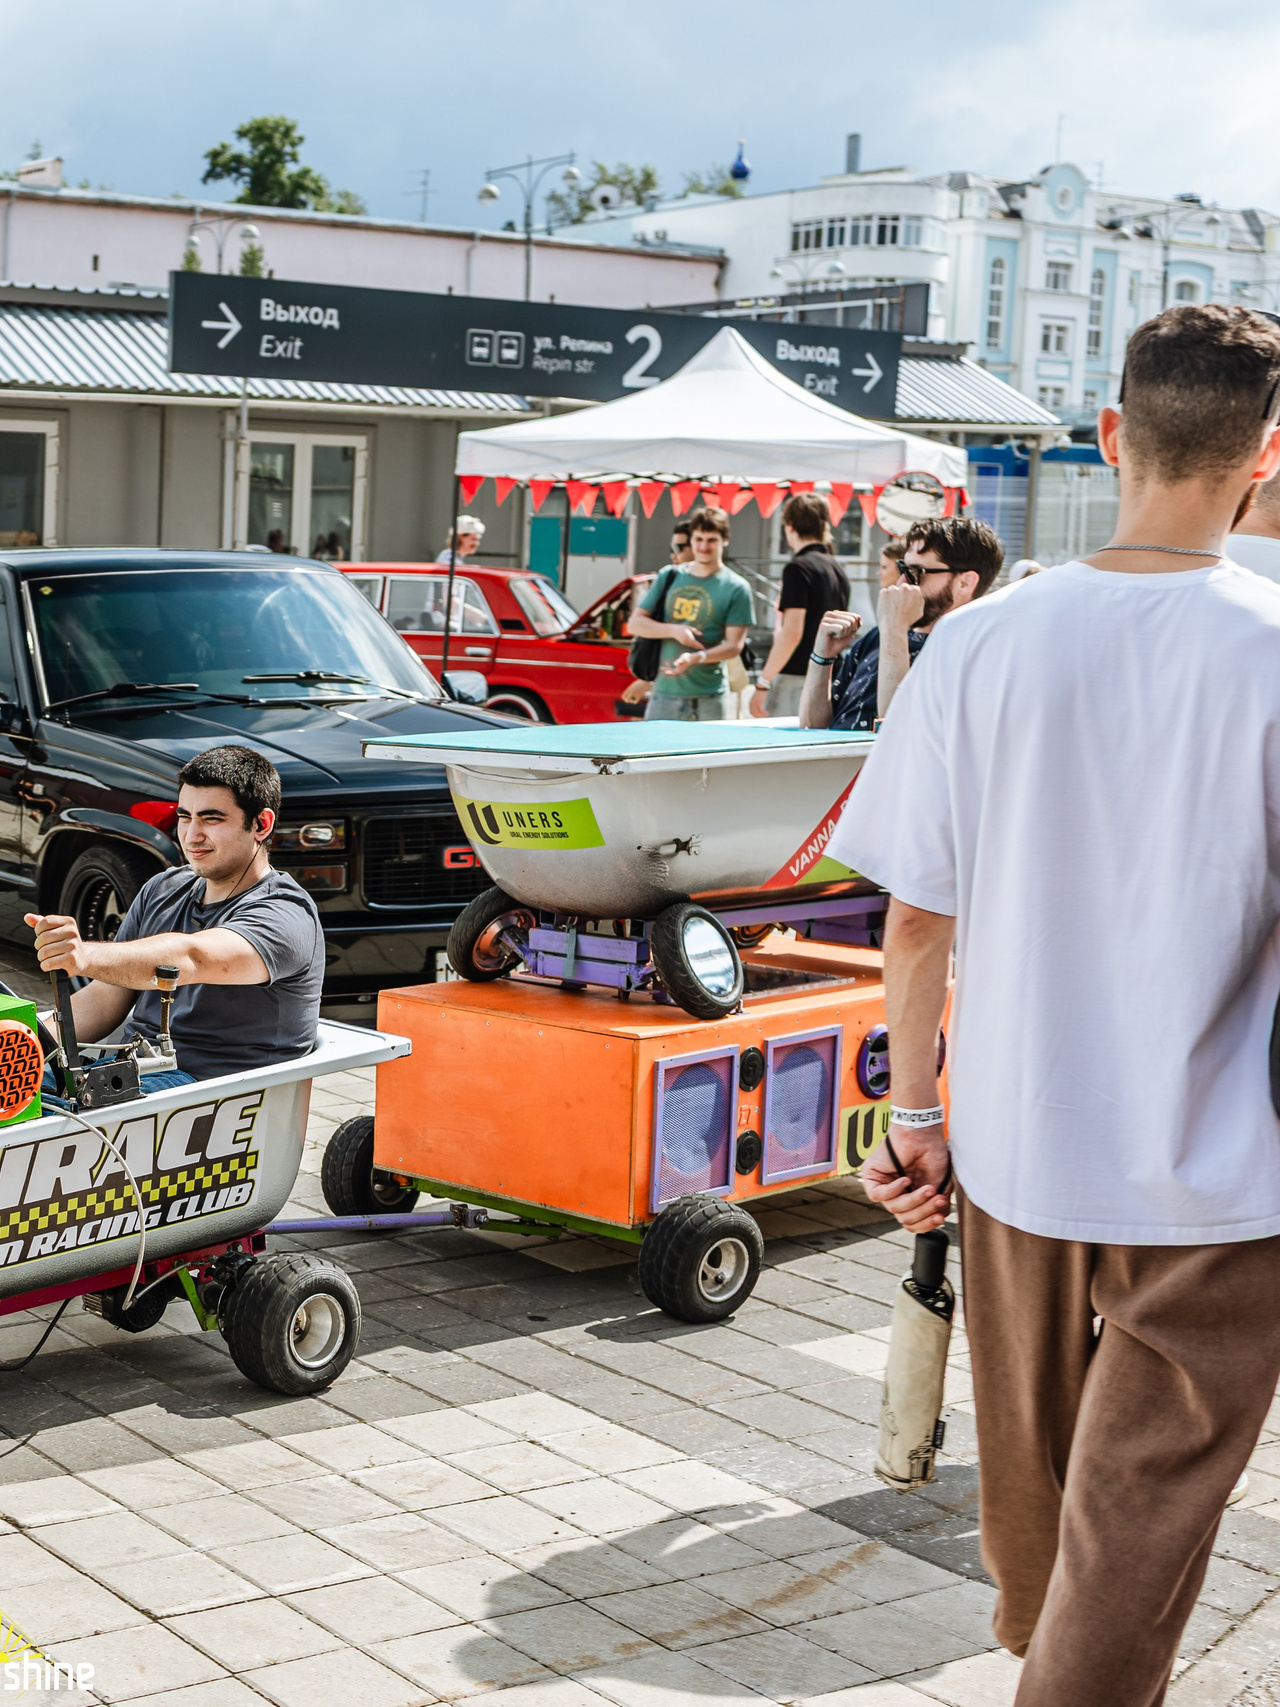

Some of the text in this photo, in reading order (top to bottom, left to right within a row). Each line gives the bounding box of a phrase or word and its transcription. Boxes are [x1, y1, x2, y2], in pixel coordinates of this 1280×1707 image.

[260, 298, 340, 330] Выход
[259, 334, 304, 360] Exit
[560, 335, 613, 354] Репина
[622, 324, 663, 388] 2
[776, 339, 841, 367] Выход
[803, 373, 839, 396] Exit
[502, 811, 563, 828] UNERS
[33, 1205, 163, 1259] RACING
[166, 1181, 255, 1224] CLUB
